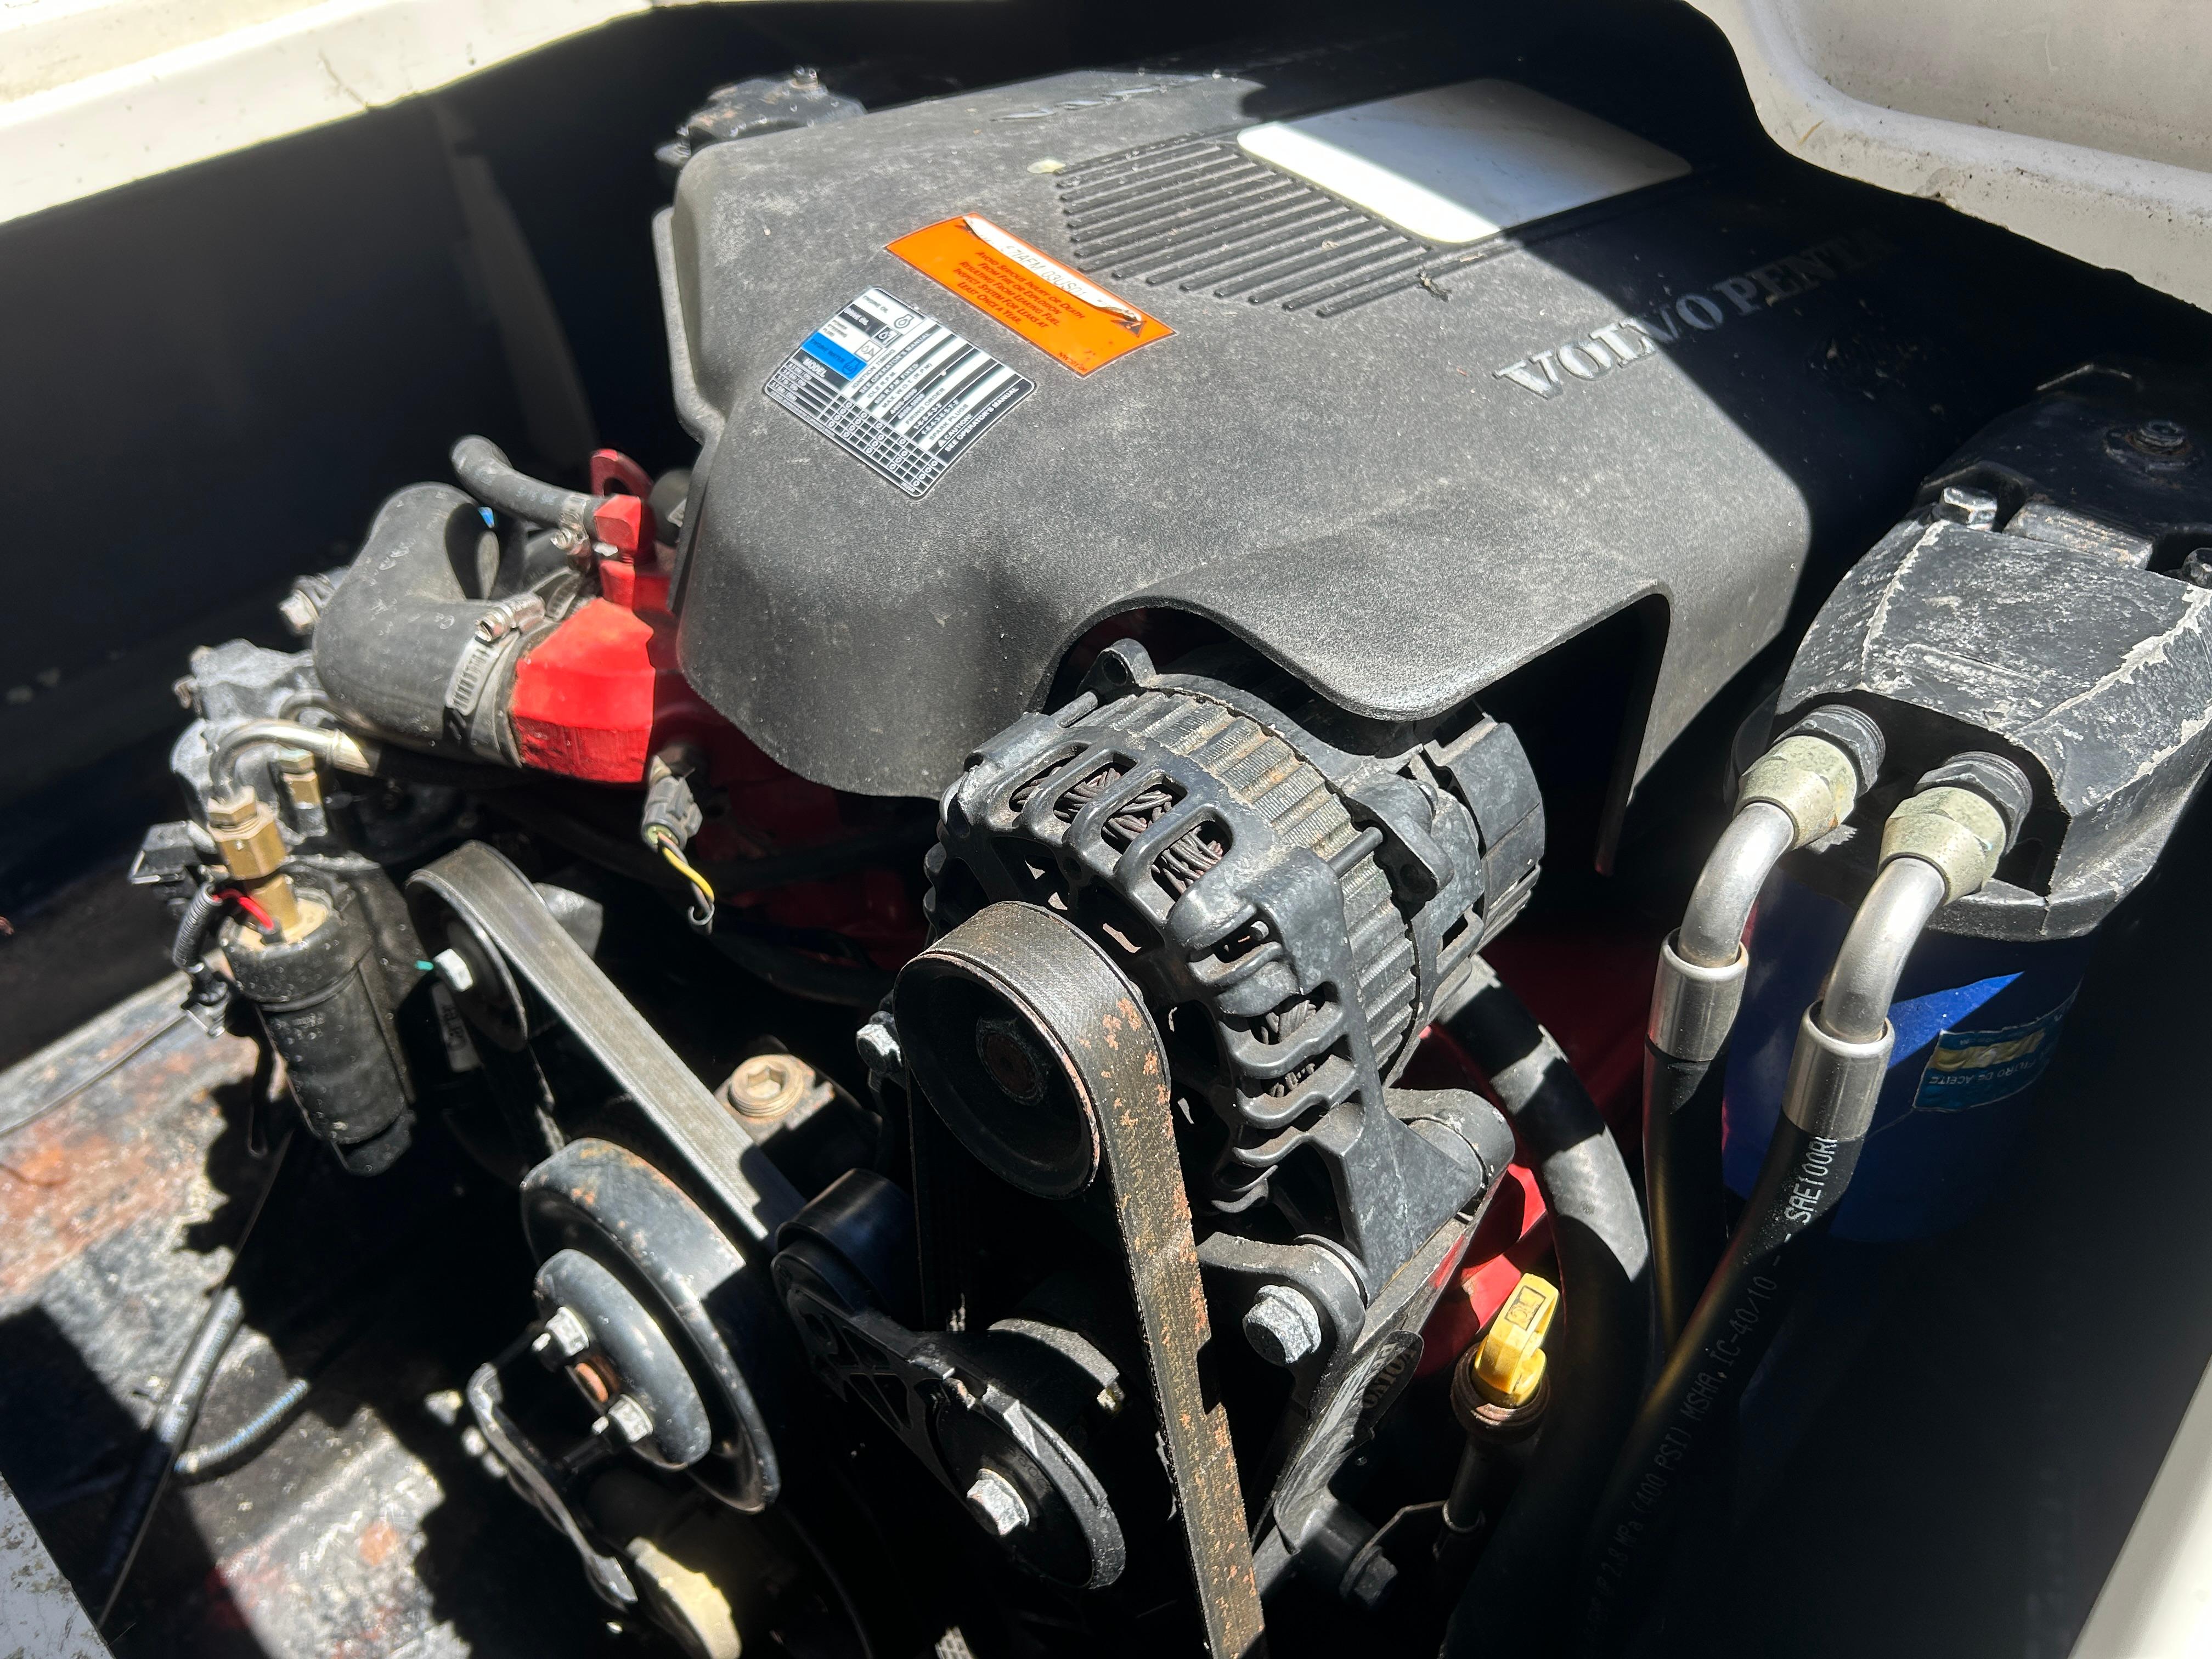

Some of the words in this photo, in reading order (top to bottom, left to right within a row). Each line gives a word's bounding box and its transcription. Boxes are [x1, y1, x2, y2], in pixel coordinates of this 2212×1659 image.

[952, 268, 981, 285] INSPECT
[977, 284, 1006, 301] SYSTEM
[1001, 298, 1020, 309] FOR
[1015, 308, 1040, 323] LEAKS
[956, 281, 980, 295] LEAST
[975, 294, 1000, 308] ONCE
[1000, 309, 1025, 324] YEAR.
[958, 261, 996, 284] RESULTING
[991, 282, 1016, 296] FROM
[1012, 295, 1045, 314] LEAKING
[974, 251, 1001, 266] AVOID
[996, 264, 1028, 282] SERIOUS
[1023, 281, 1051, 297] INJURY
[1047, 296, 1062, 304] OR
[1058, 302, 1086, 319] DEATH
[977, 262, 1001, 276] FROM
[996, 274, 1015, 285] FIRE
[1011, 284, 1025, 292] OR
[1022, 290, 1063, 315] EXPLOSION
[809, 338, 828, 353] ENGINE
[827, 349, 846, 364] WATER
[858, 381, 873, 394] SEE
[870, 350, 908, 383] OPERATOR'S
[905, 330, 932, 353] MANUAL
[1493, 293, 1723, 400] VOLVO
[802, 357, 827, 378] MODEL
[850, 365, 877, 389] IGNITION
[875, 348, 896, 366] TIMING
[900, 362, 920, 379] FIXED
[866, 385, 881, 398] IDLE
[881, 394, 897, 409] MAX.
[904, 405, 926, 425] FIRING
[923, 387, 946, 407] ORDER
[928, 421, 950, 441] SPARK
[947, 403, 969, 422] PLUGS
[942, 413, 973, 441] CAUTION!
[944, 438, 960, 452] SEE
[956, 405, 995, 441] OPERATOR'S
[991, 385, 1020, 409] MANUAL
[1977, 1072, 1994, 1081] DE
[1997, 1061, 2036, 1079] FILTRO
[1363, 1346, 1419, 1409] VOLVO
[1627, 1470, 1669, 1517] (400
[1655, 1427, 1691, 1471] PSI)
[1711, 1276, 1778, 1366] IC-40/10
